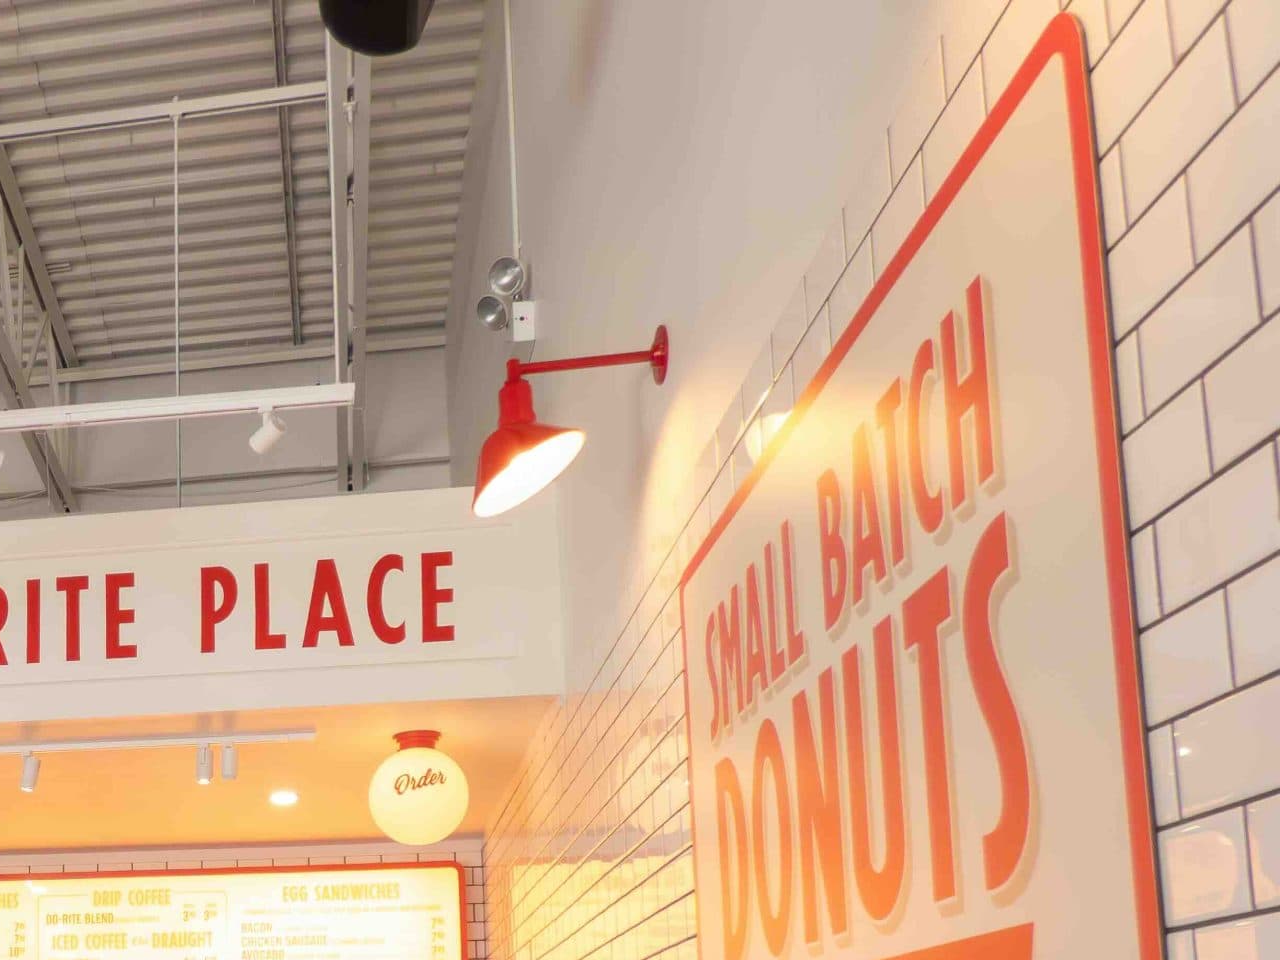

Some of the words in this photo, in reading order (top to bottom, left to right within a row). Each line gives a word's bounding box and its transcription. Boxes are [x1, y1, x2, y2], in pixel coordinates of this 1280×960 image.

[706, 518, 807, 744] SMALL
[816, 273, 1000, 632] BATCH
[200, 550, 456, 653] PLACE
[394, 768, 447, 795] Order
[92, 889, 122, 907] DRIP
[128, 888, 172, 906] COFFEE
[281, 885, 309, 903] EGG
[314, 882, 401, 901] SANDWICHES
[84, 912, 114, 924] BLEND
[241, 923, 272, 933] BACON
[51, 933, 80, 950] ICED
[85, 932, 128, 950] COFFEE
[152, 931, 213, 949] DRAUGHT
[241, 936, 282, 946] CHICKEN
